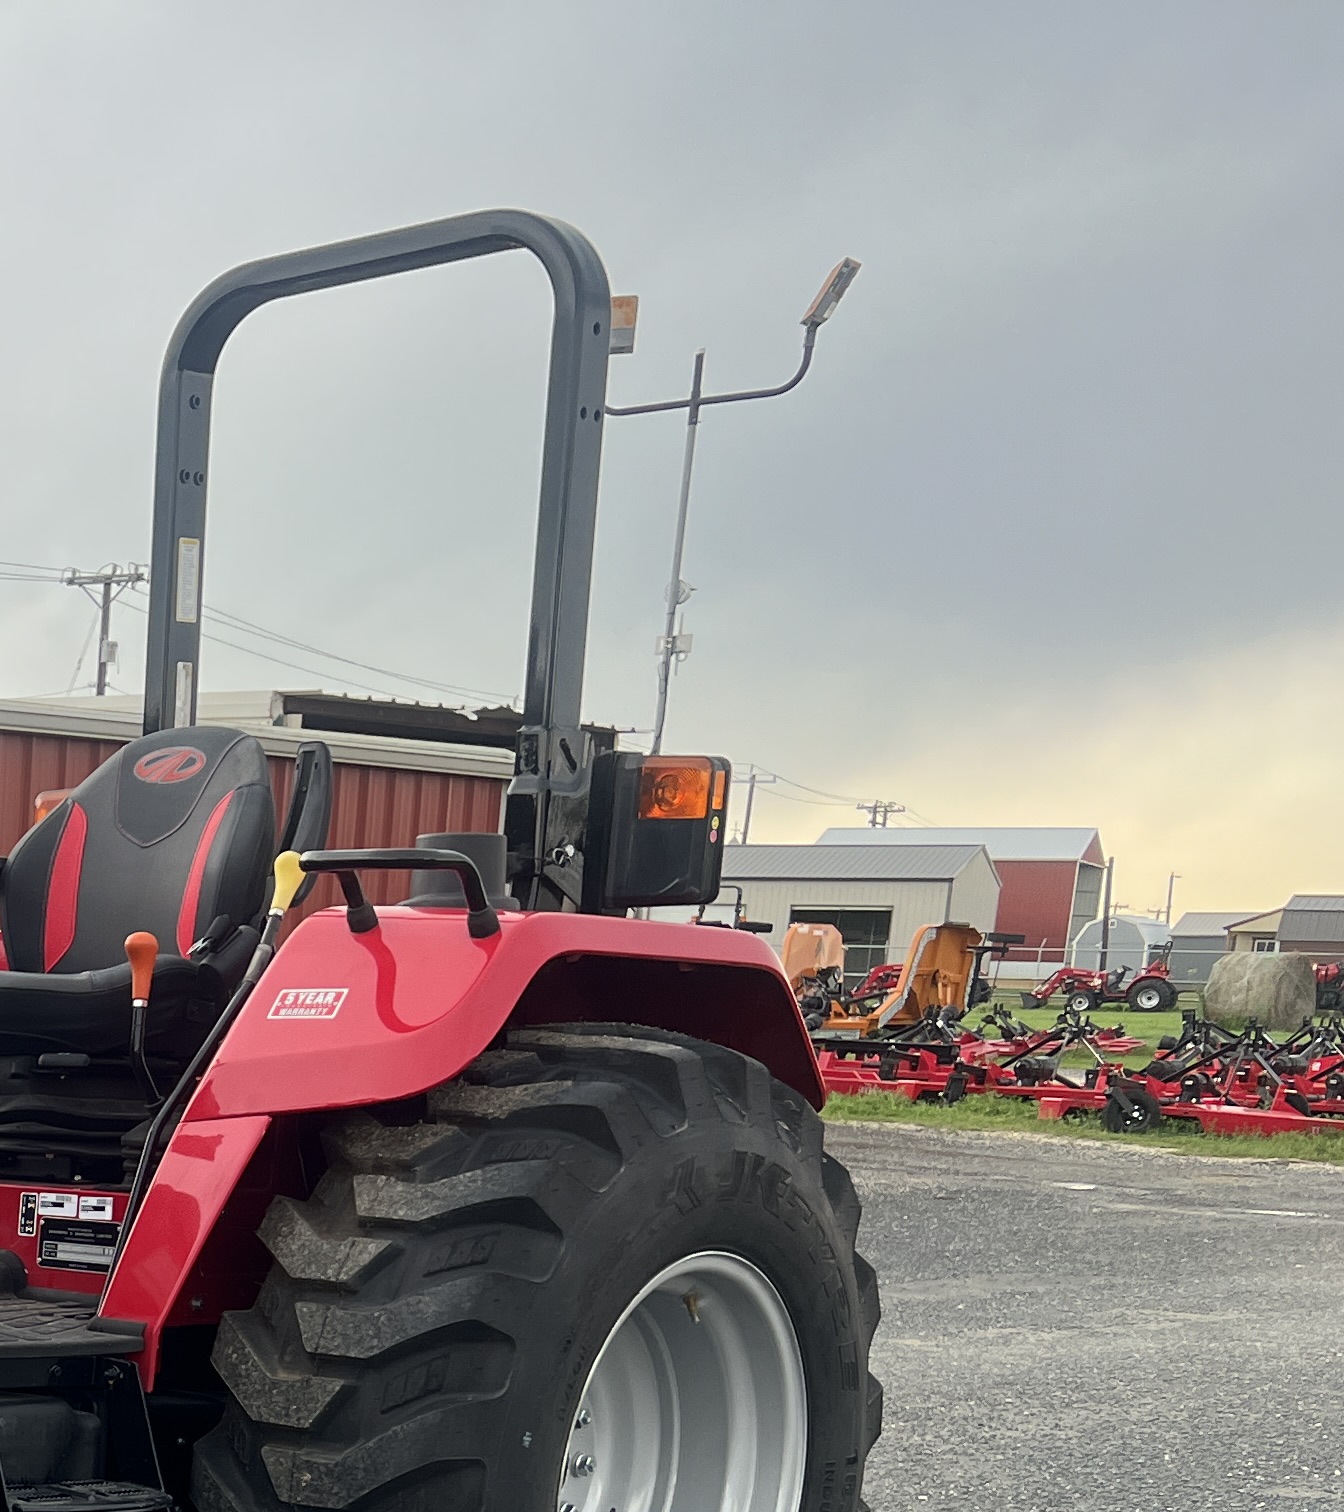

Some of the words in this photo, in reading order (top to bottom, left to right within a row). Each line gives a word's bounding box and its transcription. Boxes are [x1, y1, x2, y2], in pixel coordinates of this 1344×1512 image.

[284, 992, 297, 1005] 5
[296, 991, 336, 1005] YEAR
[278, 1007, 329, 1016] WARRANTY
